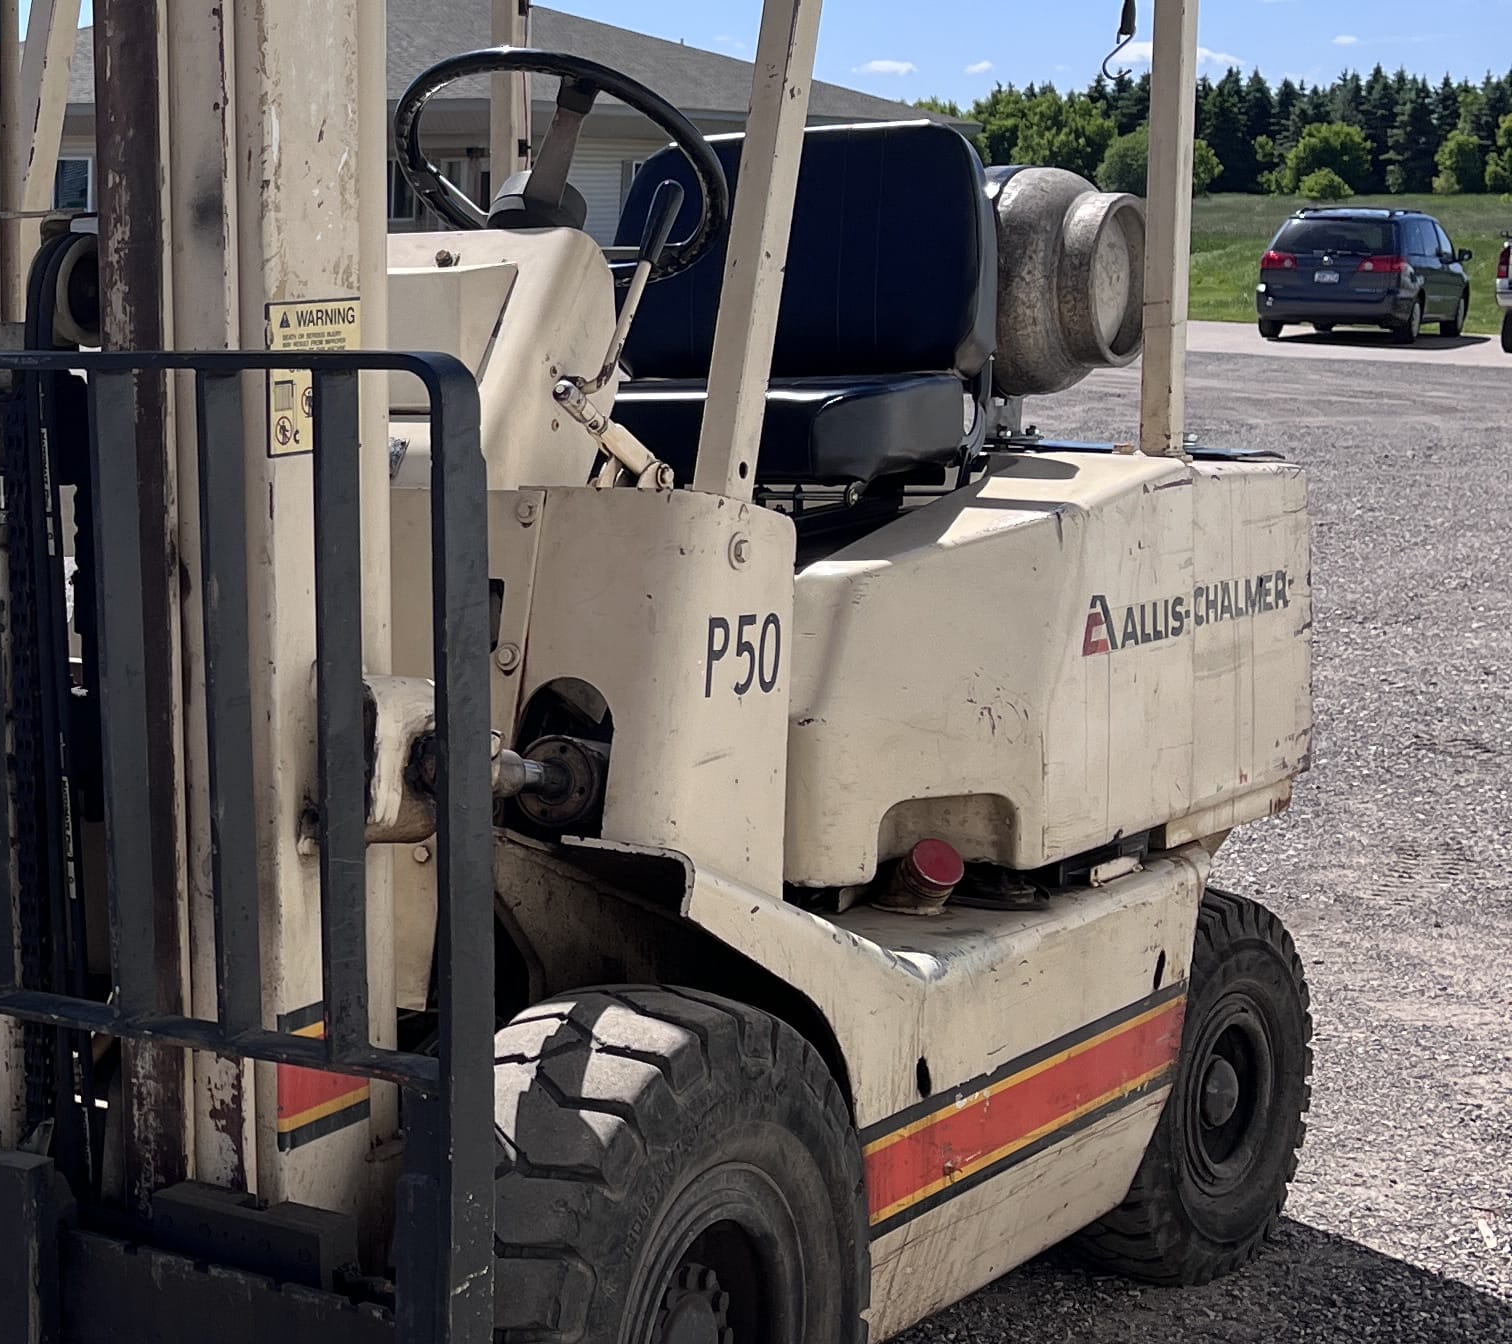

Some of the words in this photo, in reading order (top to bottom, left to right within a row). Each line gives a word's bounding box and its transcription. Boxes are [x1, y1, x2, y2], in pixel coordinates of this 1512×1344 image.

[296, 306, 356, 328] WARNING
[1121, 569, 1292, 649] ALLIS-CHALMER
[704, 612, 781, 698] P50
